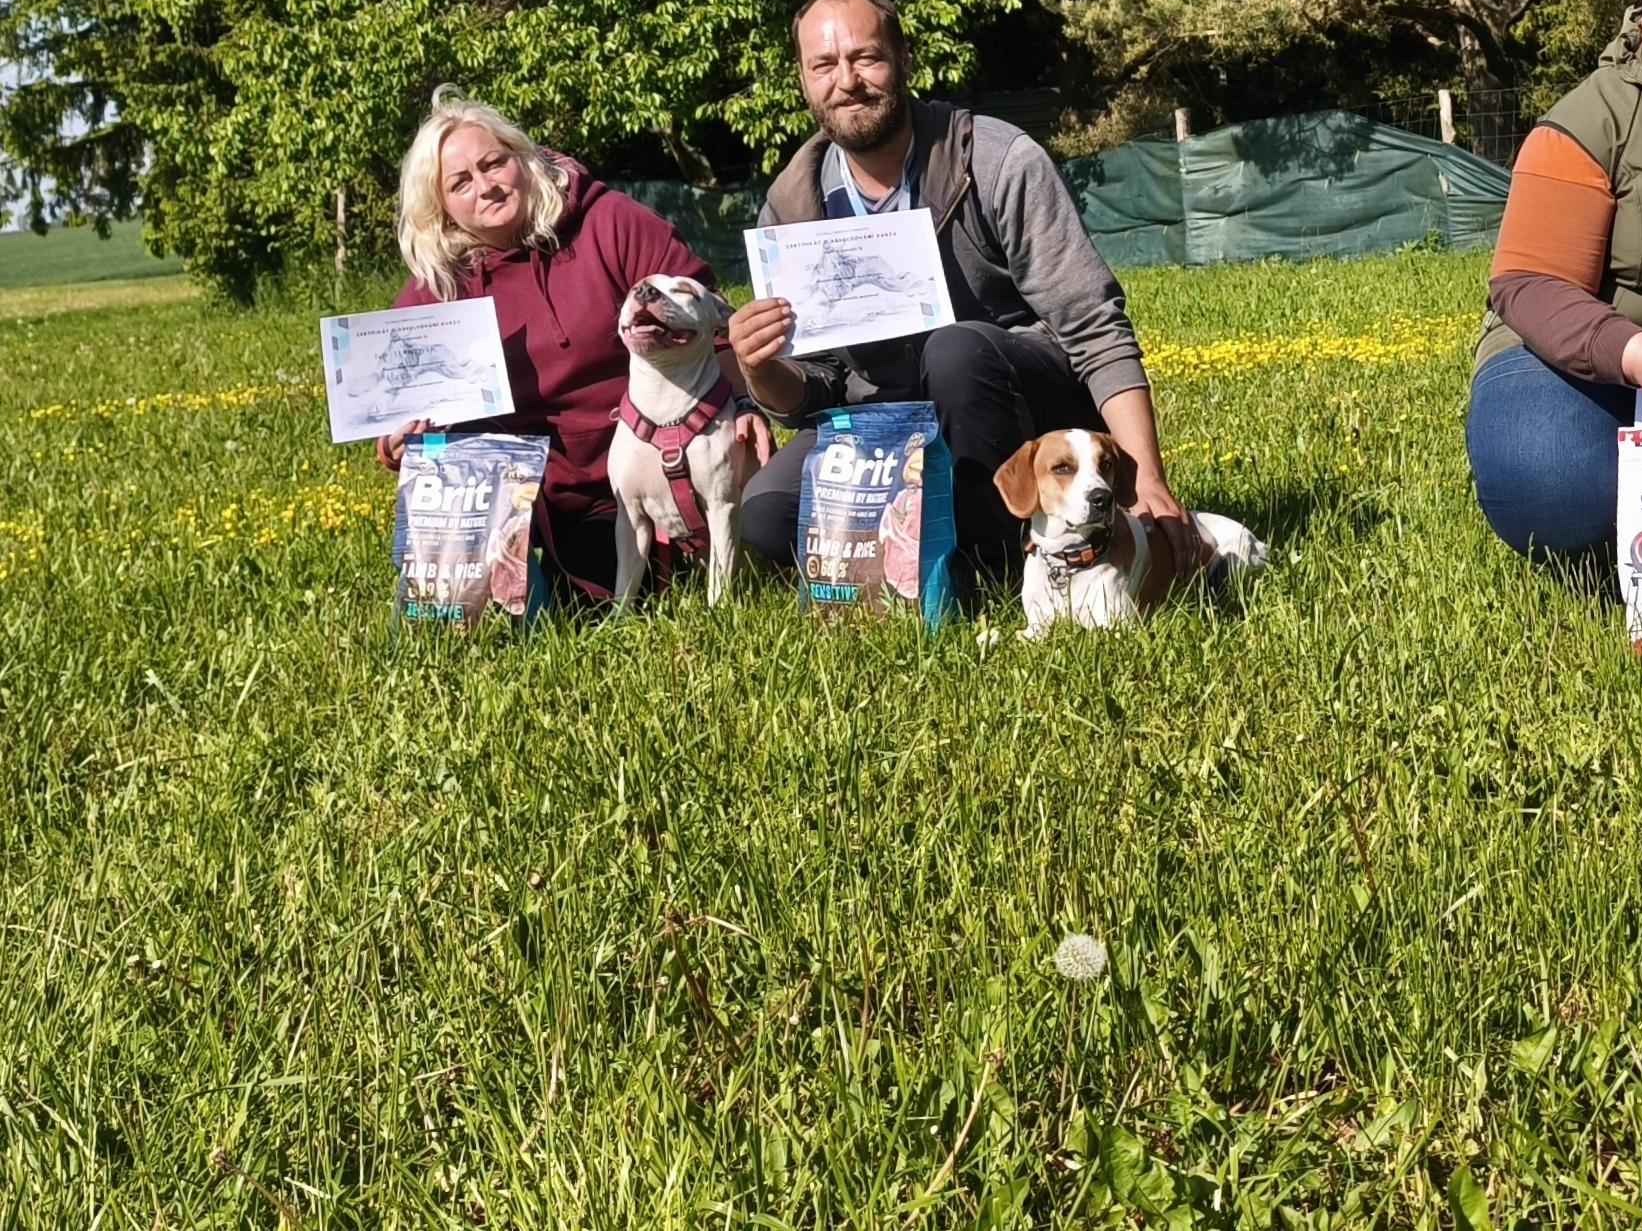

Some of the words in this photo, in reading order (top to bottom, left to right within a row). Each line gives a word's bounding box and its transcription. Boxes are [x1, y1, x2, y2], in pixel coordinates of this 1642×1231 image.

[818, 444, 899, 486] Brit
[410, 475, 493, 512] Brit
[806, 536, 841, 558] LAMB
[853, 540, 877, 559] RICE
[454, 562, 484, 580] RICE
